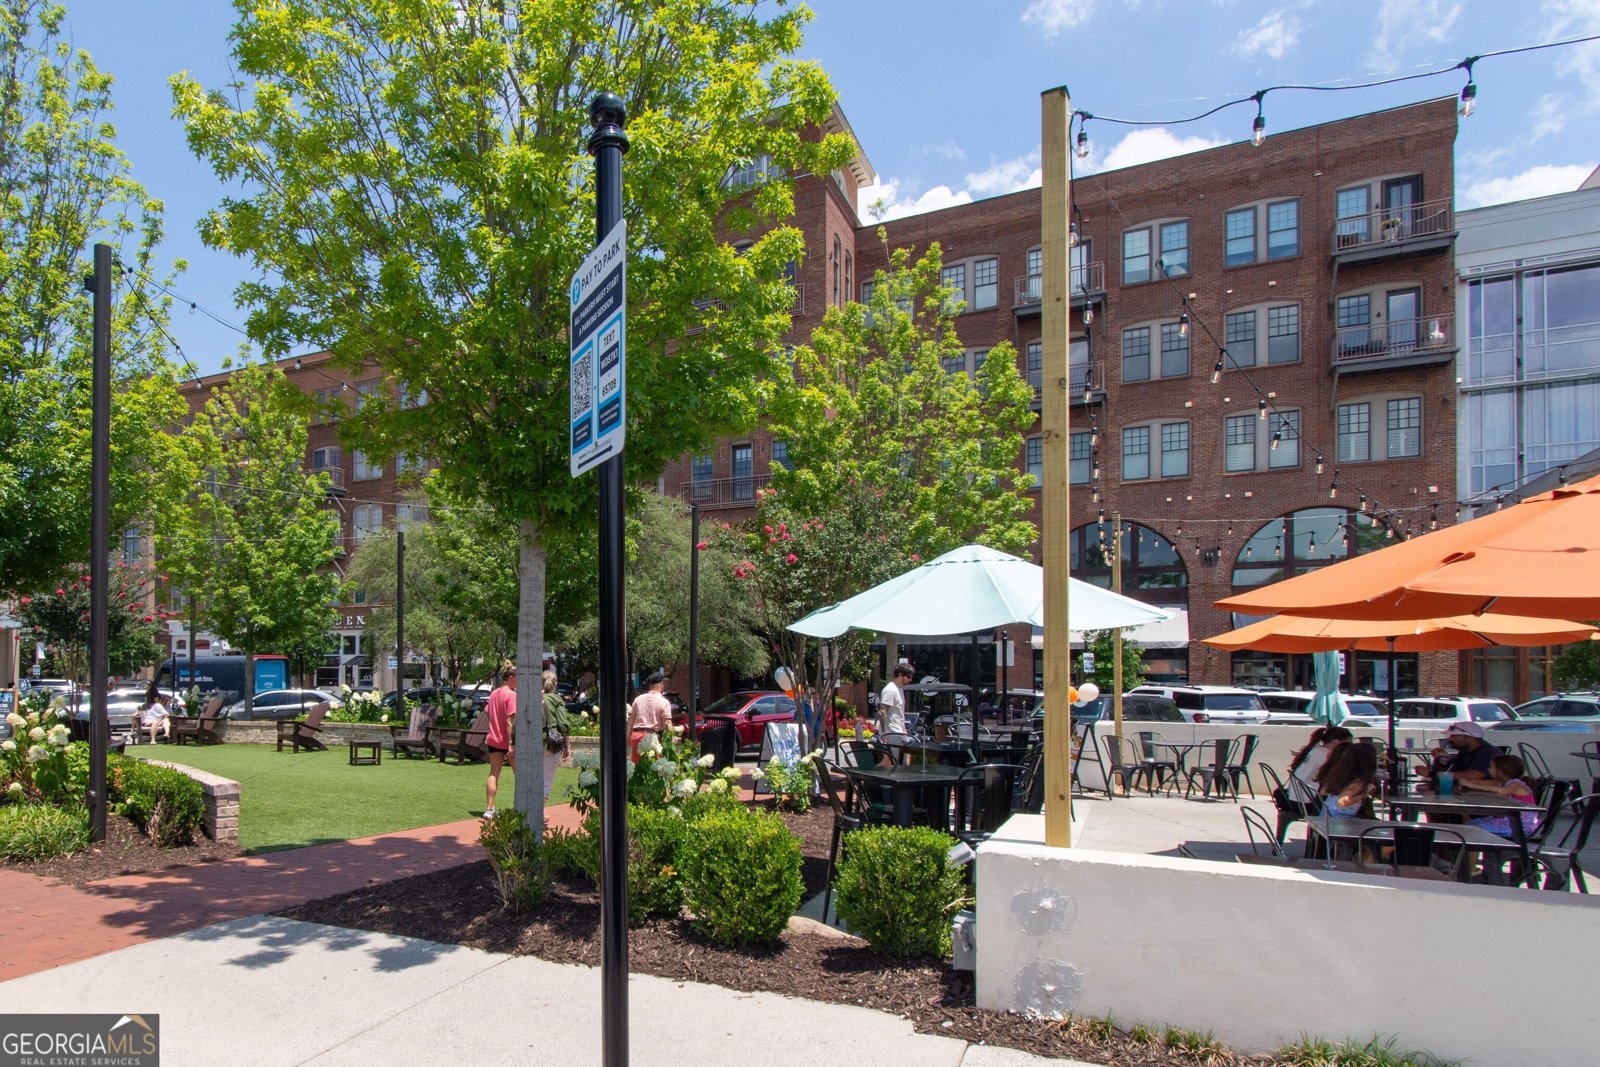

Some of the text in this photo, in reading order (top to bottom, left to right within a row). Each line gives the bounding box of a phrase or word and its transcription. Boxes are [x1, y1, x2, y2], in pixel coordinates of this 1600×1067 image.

[582, 270, 592, 292] PAY
[594, 260, 602, 277] TO
[604, 238, 620, 268] PARK
[580, 299, 596, 320] PARKERS
[596, 288, 606, 306] MUST
[606, 273, 619, 293] START
[582, 311, 596, 333] PARKING
[598, 296, 614, 318] SESSION
[604, 330, 615, 346] TEXT
